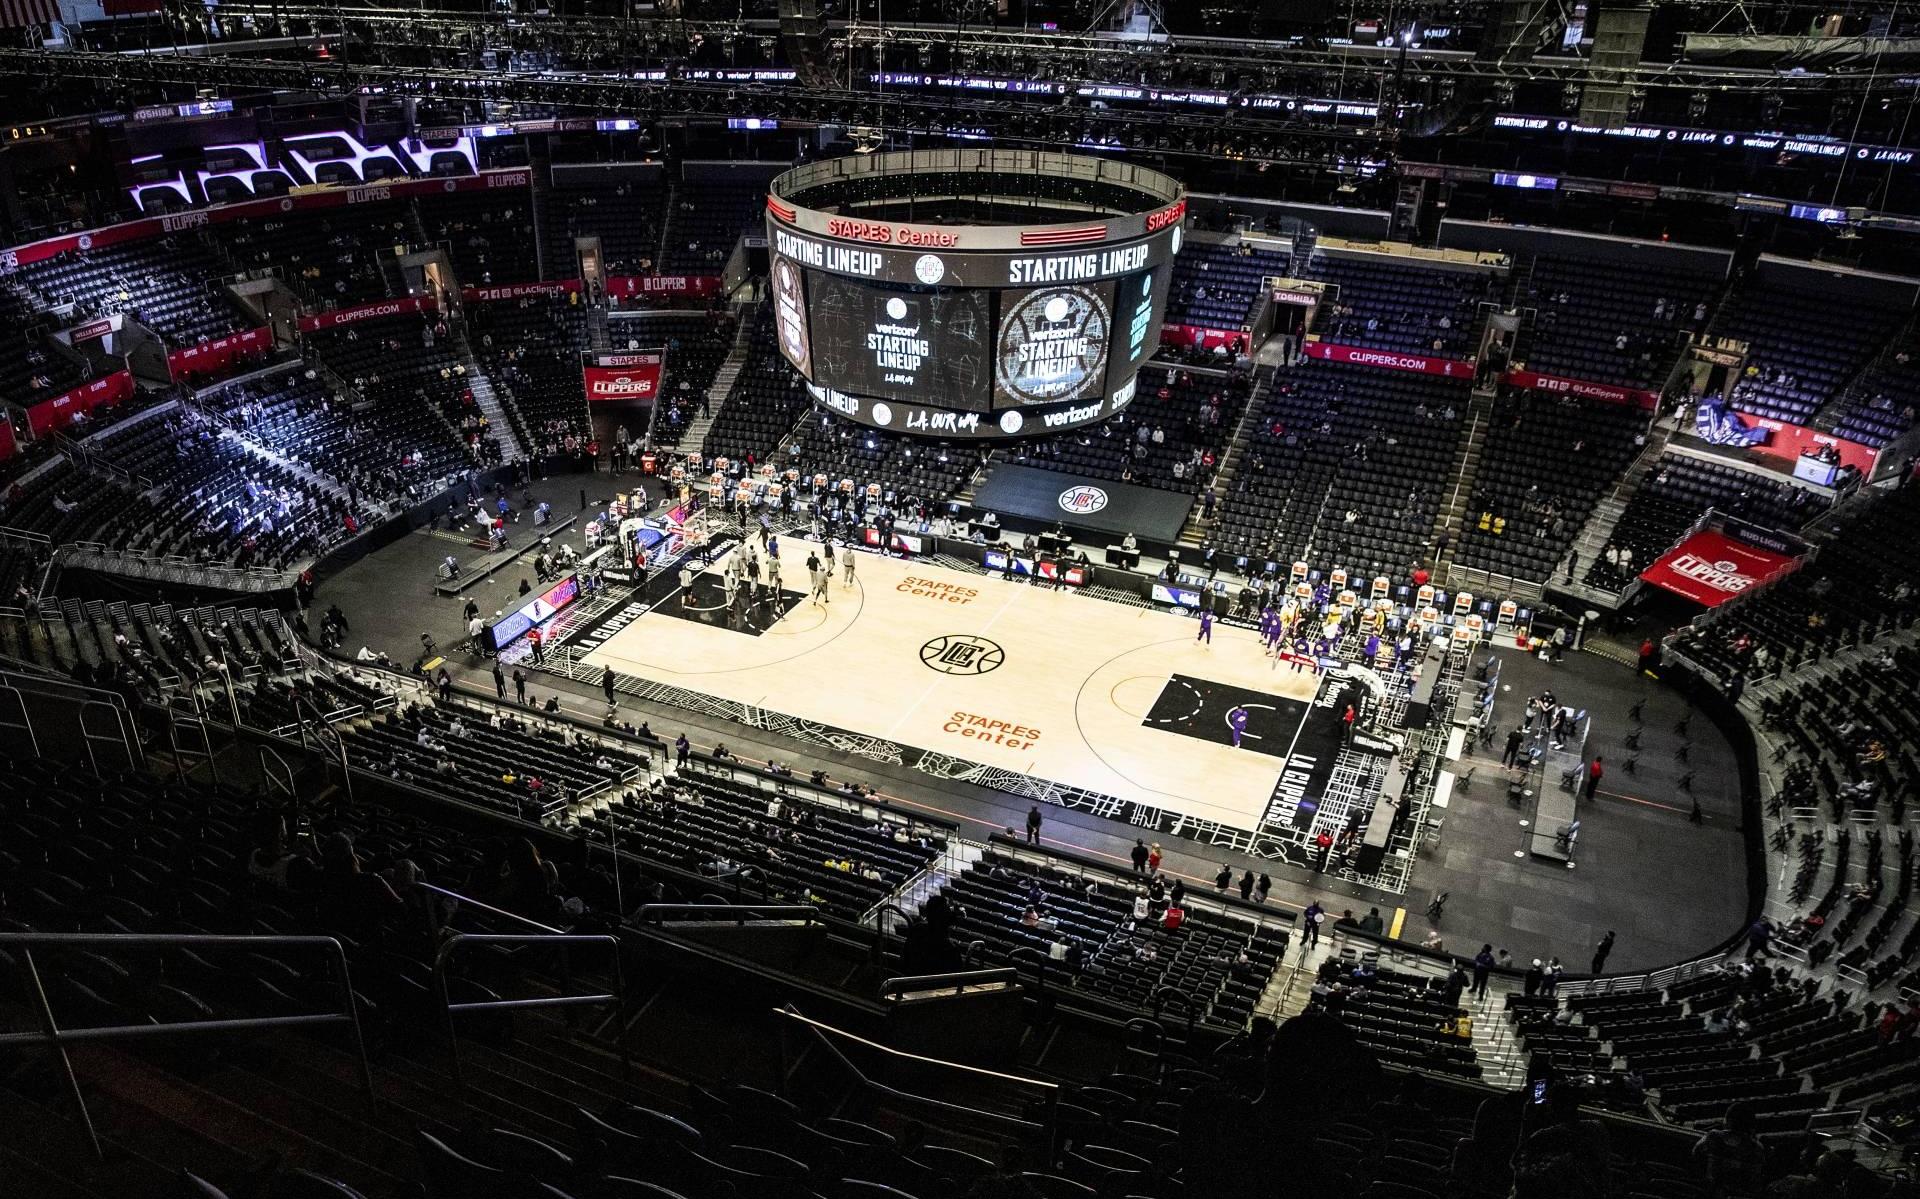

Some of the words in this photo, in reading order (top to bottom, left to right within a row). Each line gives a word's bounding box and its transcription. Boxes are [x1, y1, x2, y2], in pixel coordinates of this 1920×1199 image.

[134, 106, 175, 120] TOSHIBA
[1336, 105, 1364, 115] STARTING
[1495, 117, 1524, 127] STARTING
[1525, 119, 1548, 128] LINEUP
[421, 128, 459, 139] STAPLES
[1636, 128, 1660, 138] LINEUP
[1744, 139, 1779, 148] verizon
[1784, 141, 1819, 153] STARTING
[1819, 144, 1846, 156] LINEUP
[495, 173, 526, 187] CLIPPERS
[356, 187, 391, 201] CLIPPERS
[172, 212, 209, 231] CLIPPERS
[1146, 207, 1181, 232] STAPLES
[827, 219, 891, 242] STAPLES
[896, 228, 959, 247] Center
[776, 229, 823, 267] STARTING
[826, 246, 882, 276] LINEUP
[1009, 254, 1097, 283] STARTING
[1101, 244, 1149, 276] LINEUP
[652, 277, 687, 291] CLIPPERS
[1274, 292, 1316, 305] TOSHIBA
[335, 304, 400, 324] CLIPPERS.COM
[875, 323, 920, 337] verizon
[1029, 325, 1081, 341] verizon
[867, 333, 929, 357] STARTING
[1018, 337, 1088, 362] STARTING
[611, 355, 649, 365] STAPLES
[876, 351, 921, 371] LINEUP
[1026, 356, 1077, 380] LINEUP
[1349, 351, 1427, 370] CLIPPERS.COM
[593, 380, 651, 394] CLIPPERS
[1572, 385, 1625, 400] @LAClippers
[826, 388, 859, 416] LINEUP
[1044, 400, 1104, 427] verizon
[1739, 529, 1759, 541] BUD
[1759, 536, 1788, 551] LIGHT
[1670, 554, 1754, 592] CLIPPERS
[896, 583, 972, 605] Center
[903, 576, 979, 597] STAPLES
[572, 639, 602, 652] LA
[591, 601, 651, 640] CLIPPERS
[1314, 681, 1350, 708] honey
[951, 711, 1042, 740] STAPLES
[943, 721, 1035, 751] Center
[1288, 753, 1317, 769] LA
[1266, 769, 1311, 825] CLIPPERS
